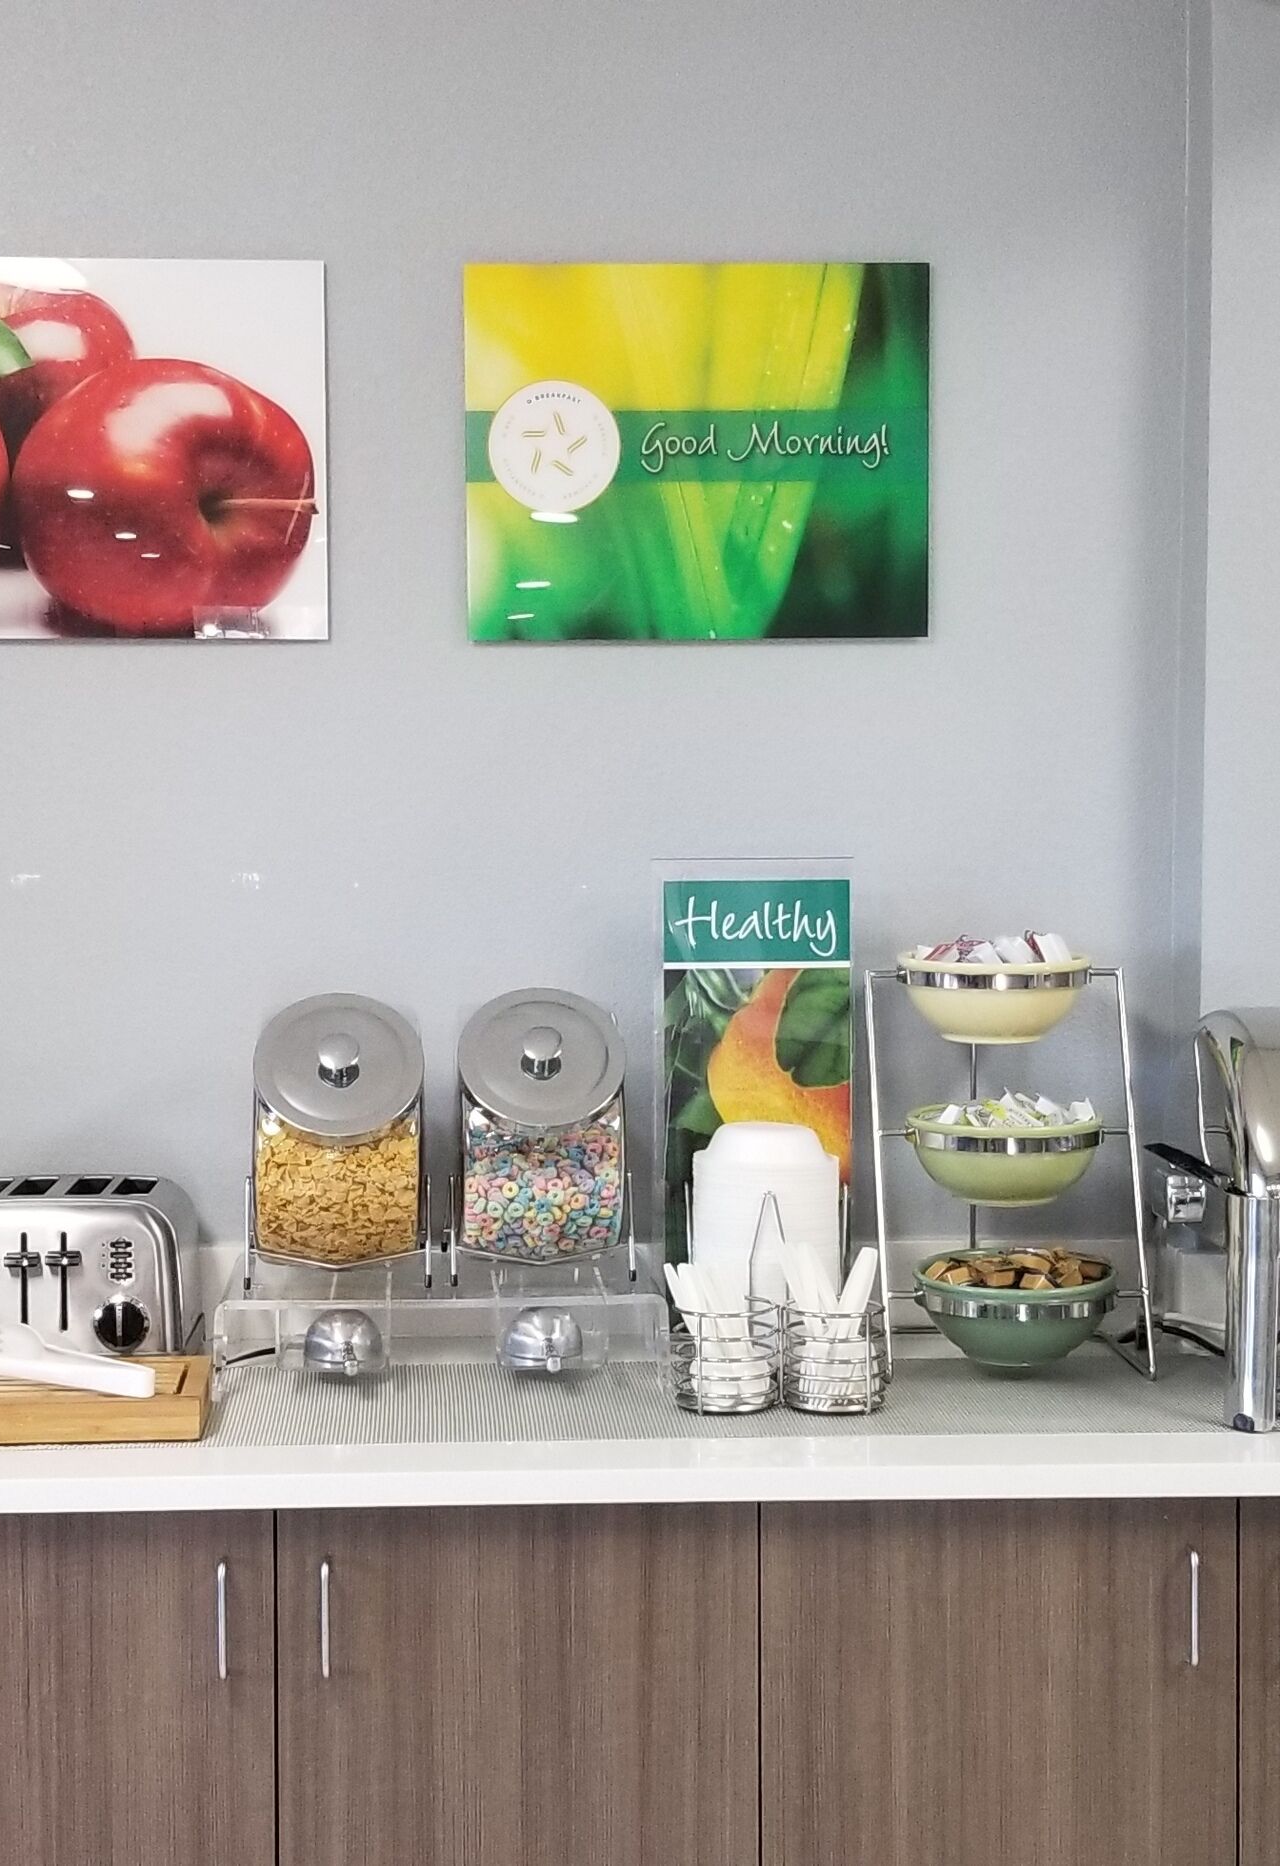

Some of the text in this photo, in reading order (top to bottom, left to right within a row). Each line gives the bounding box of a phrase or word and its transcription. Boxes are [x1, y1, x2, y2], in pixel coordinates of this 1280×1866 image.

[535, 392, 582, 404] BREAKFAST
[640, 422, 718, 473] Good
[726, 420, 890, 469] Morning!
[674, 895, 838, 957] Healthy
